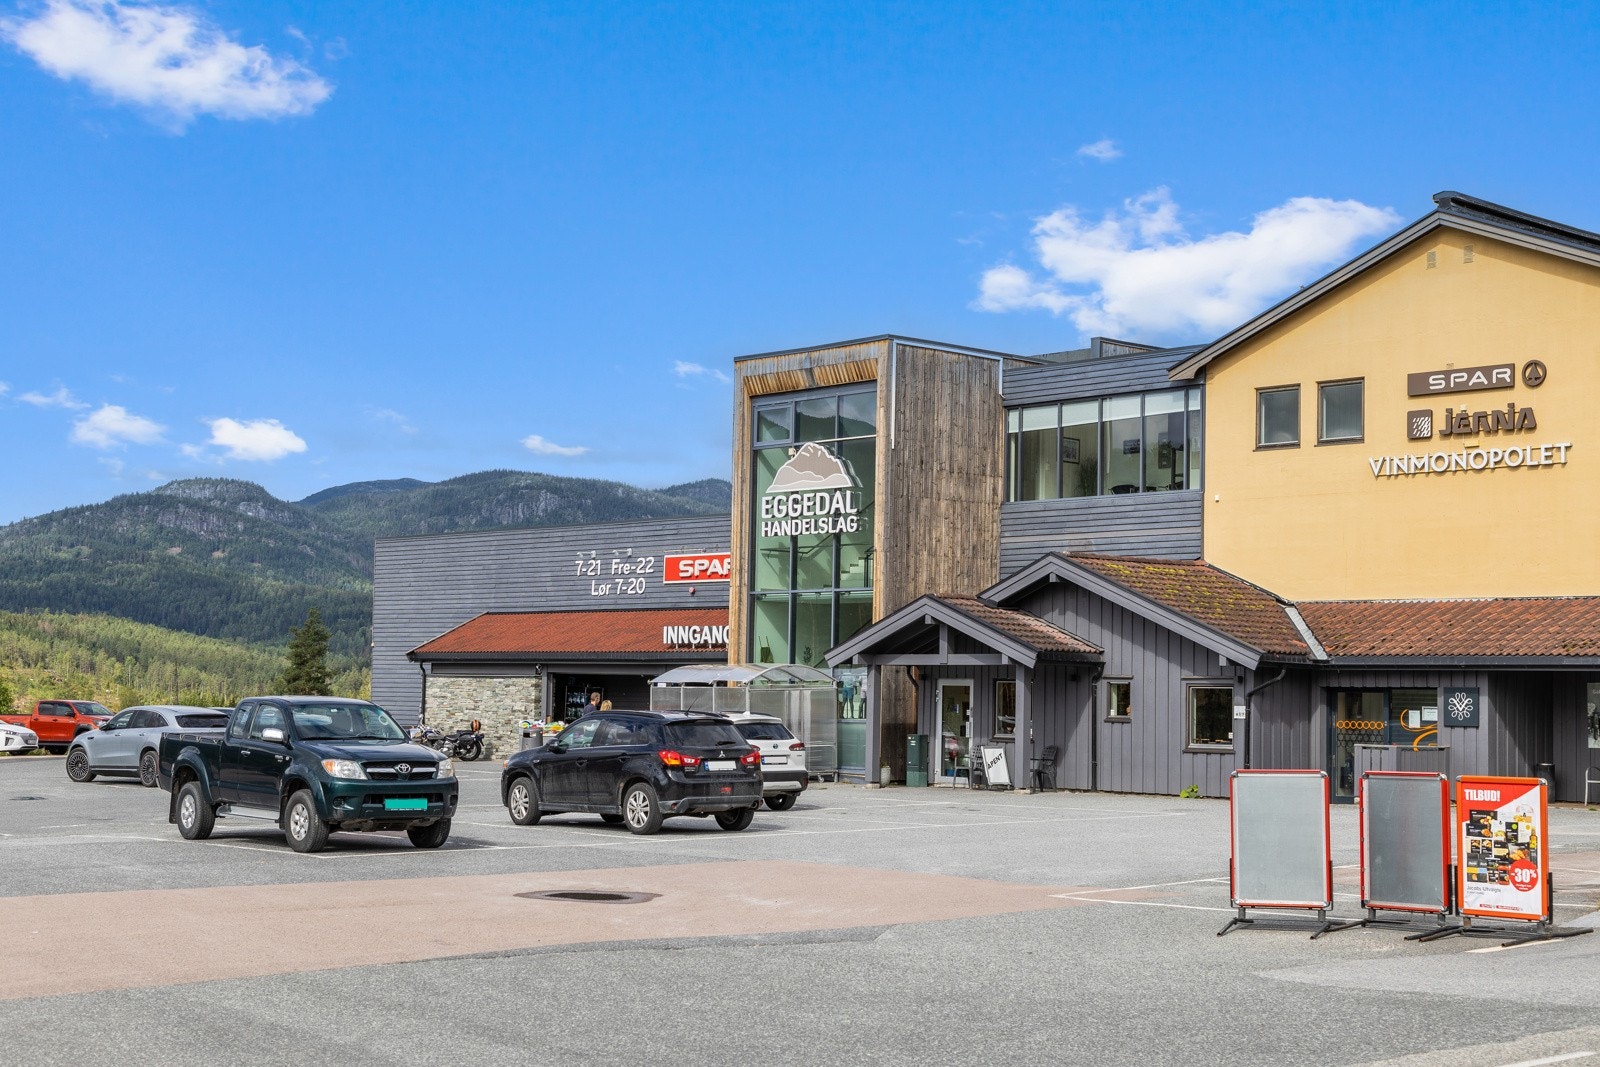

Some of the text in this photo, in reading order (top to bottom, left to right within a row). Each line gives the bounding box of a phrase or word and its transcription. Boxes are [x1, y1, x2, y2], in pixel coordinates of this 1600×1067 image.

[1429, 368, 1511, 390] SPAR
[1369, 442, 1573, 477] VINMONOPOLET
[762, 490, 858, 519] EGGEDAL
[762, 515, 858, 537] HANDELSLAG
[575, 557, 654, 577] 7-21 Fre-22
[591, 577, 646, 597] Lør 7-20
[1464, 788, 1501, 802] TILBUD!
[1510, 867, 1537, 883] -30%
